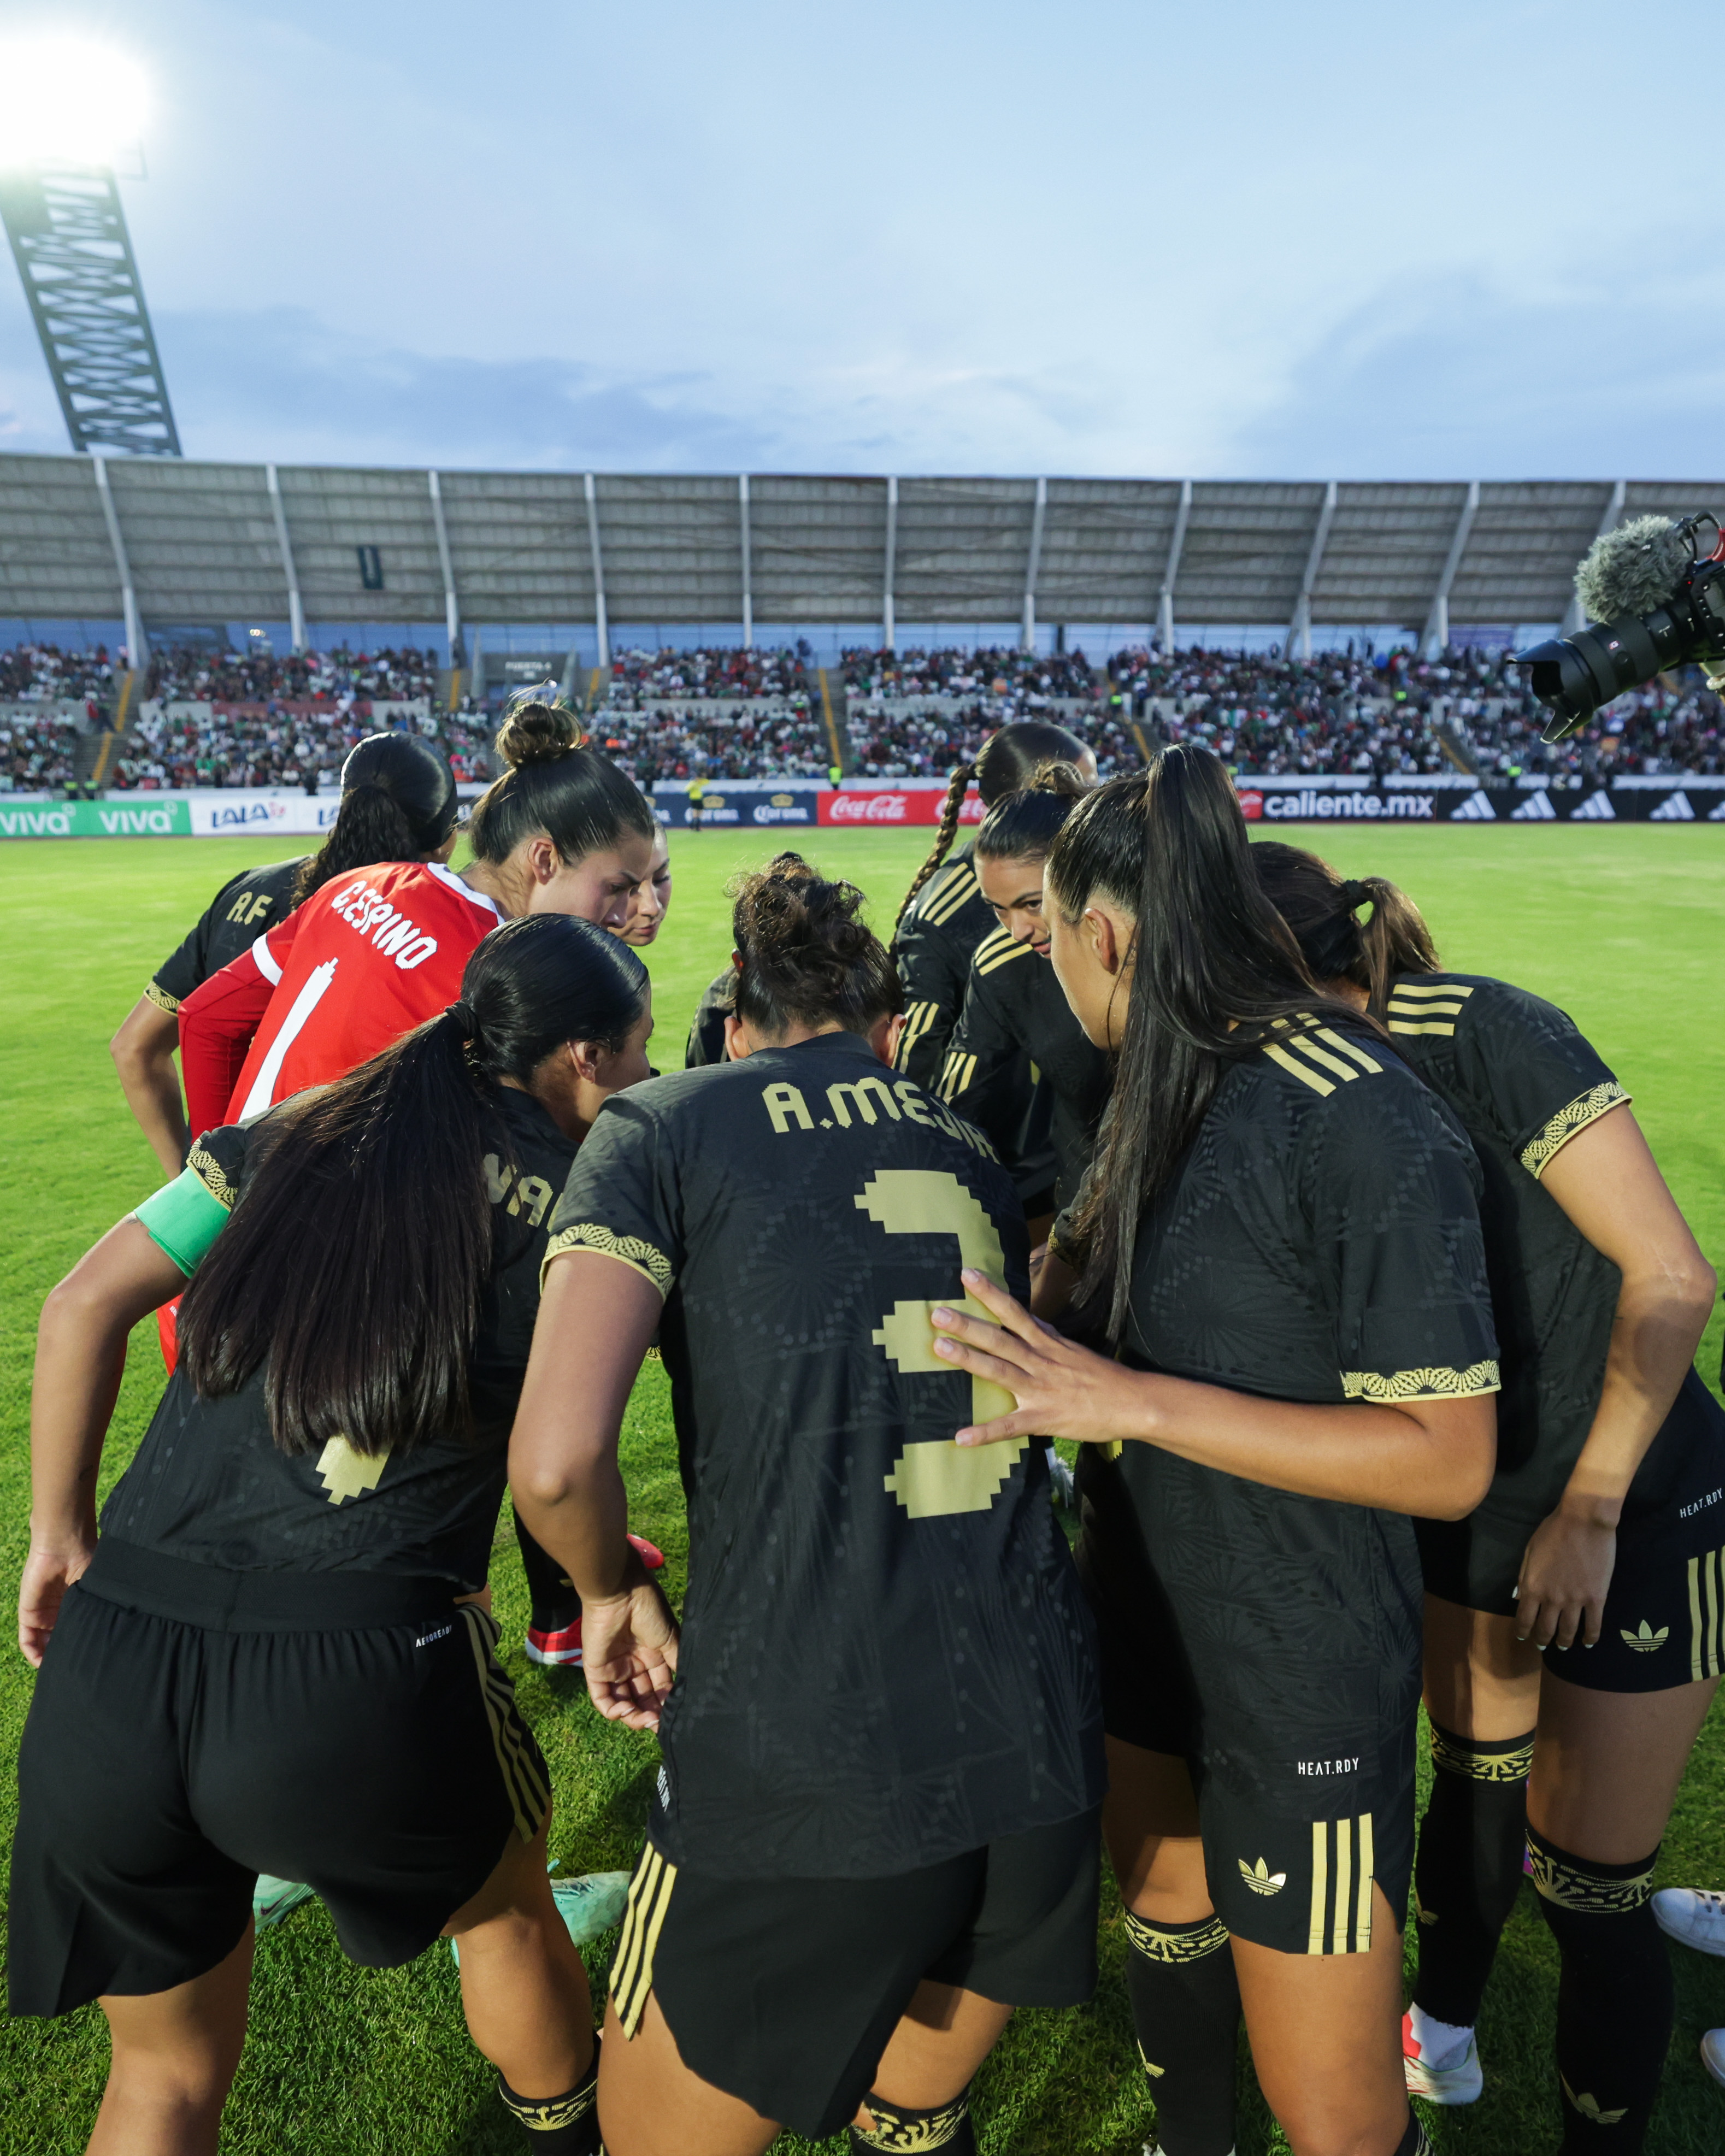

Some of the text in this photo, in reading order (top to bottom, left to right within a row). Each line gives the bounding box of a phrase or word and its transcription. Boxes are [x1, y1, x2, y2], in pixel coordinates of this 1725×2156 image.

[211, 803, 269, 828] LALA
[753, 805, 809, 823] Corona
[829, 795, 908, 820] Coca-Cola
[1263, 790, 1434, 817] caliente.mx
[331, 880, 437, 969] C.ESPINO
[237, 957, 339, 1123] 1
[483, 1153, 563, 1232] VA
[854, 1169, 1029, 1519] 3
[1680, 1488, 1723, 1518] HEAT.RDY
[1298, 1758, 1359, 1776] HEAT.RDY
